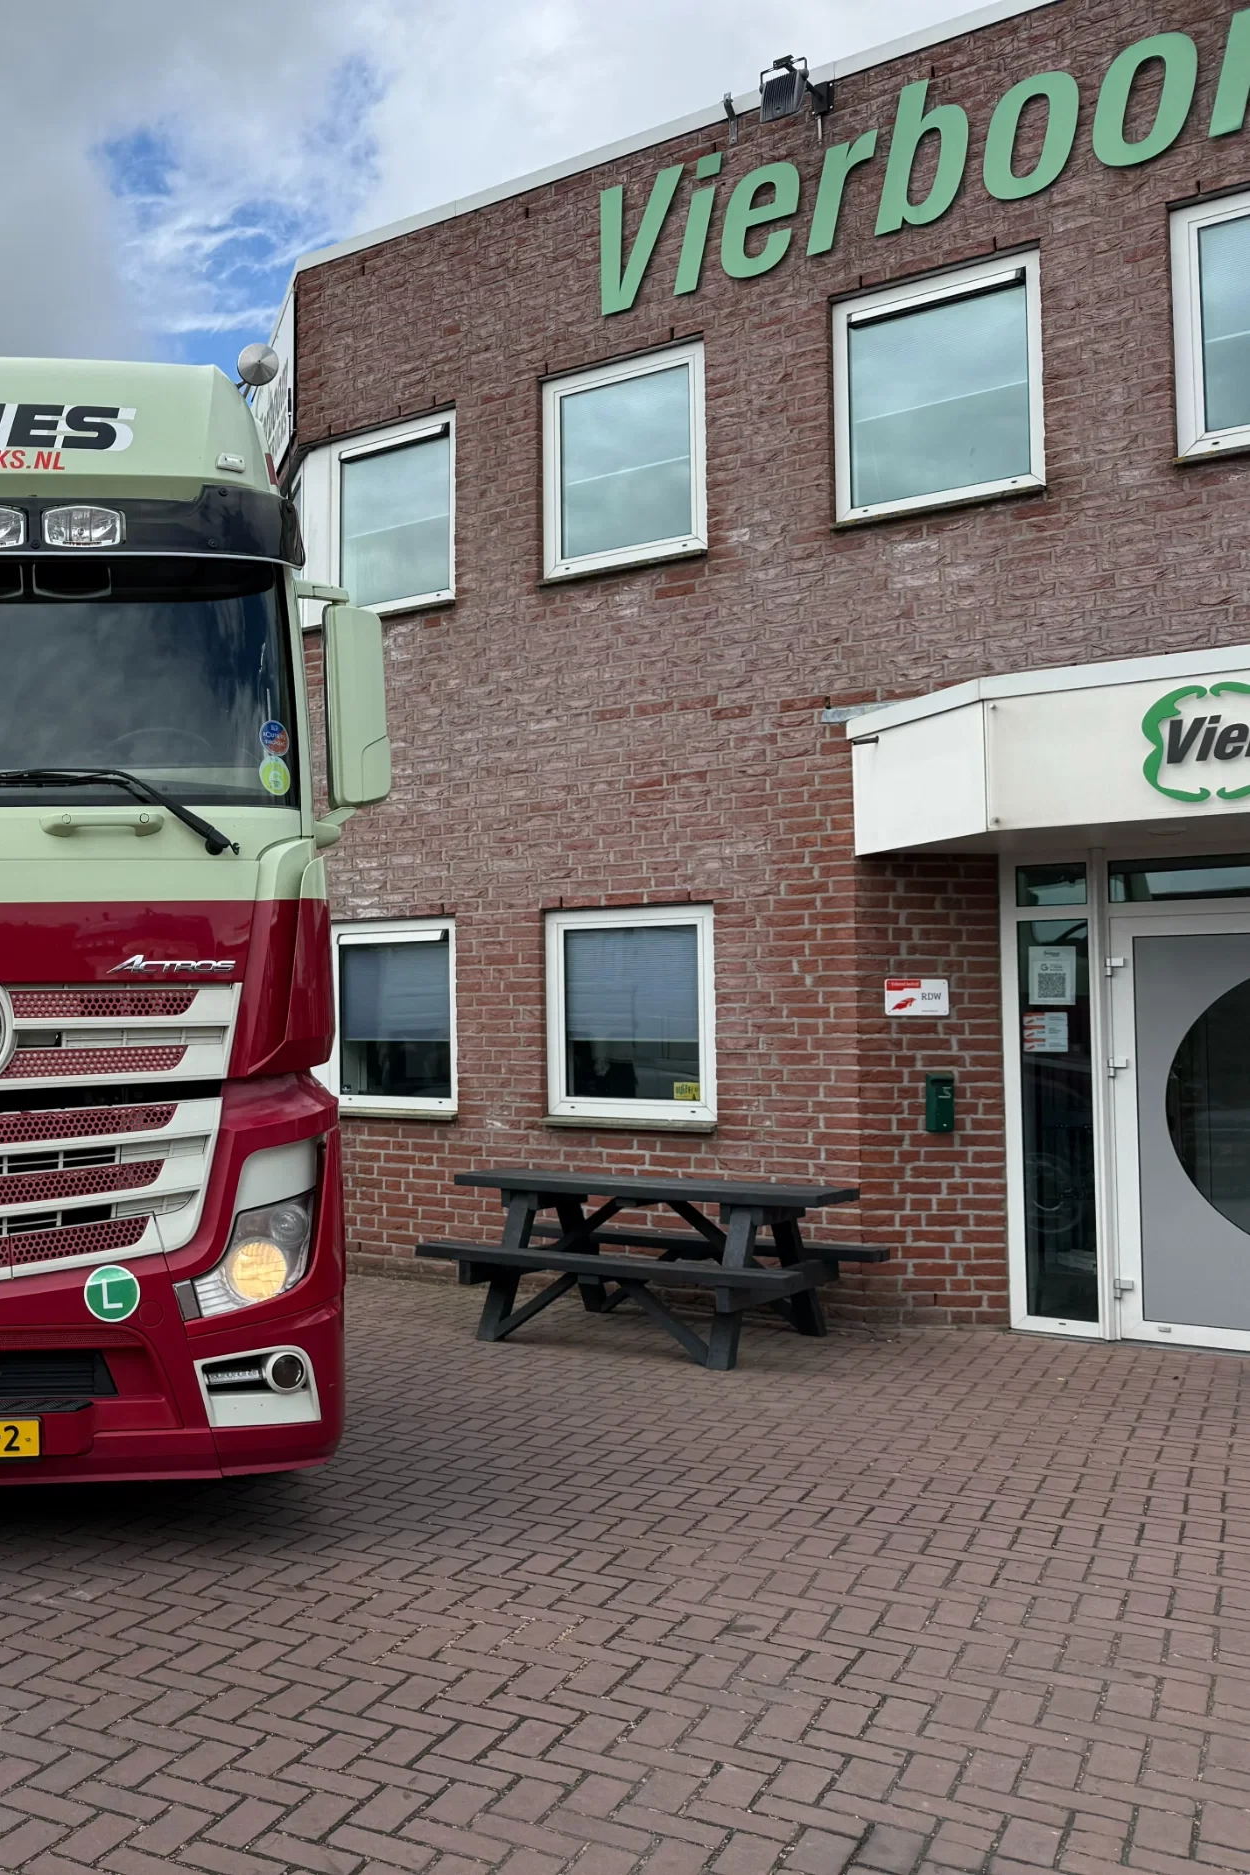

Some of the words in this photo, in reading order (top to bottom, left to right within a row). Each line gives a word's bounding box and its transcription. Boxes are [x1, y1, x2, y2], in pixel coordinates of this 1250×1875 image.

[1166, 714, 1250, 764] Vie
[920, 992, 942, 1001] RDW
[101, 1278, 123, 1310] L
